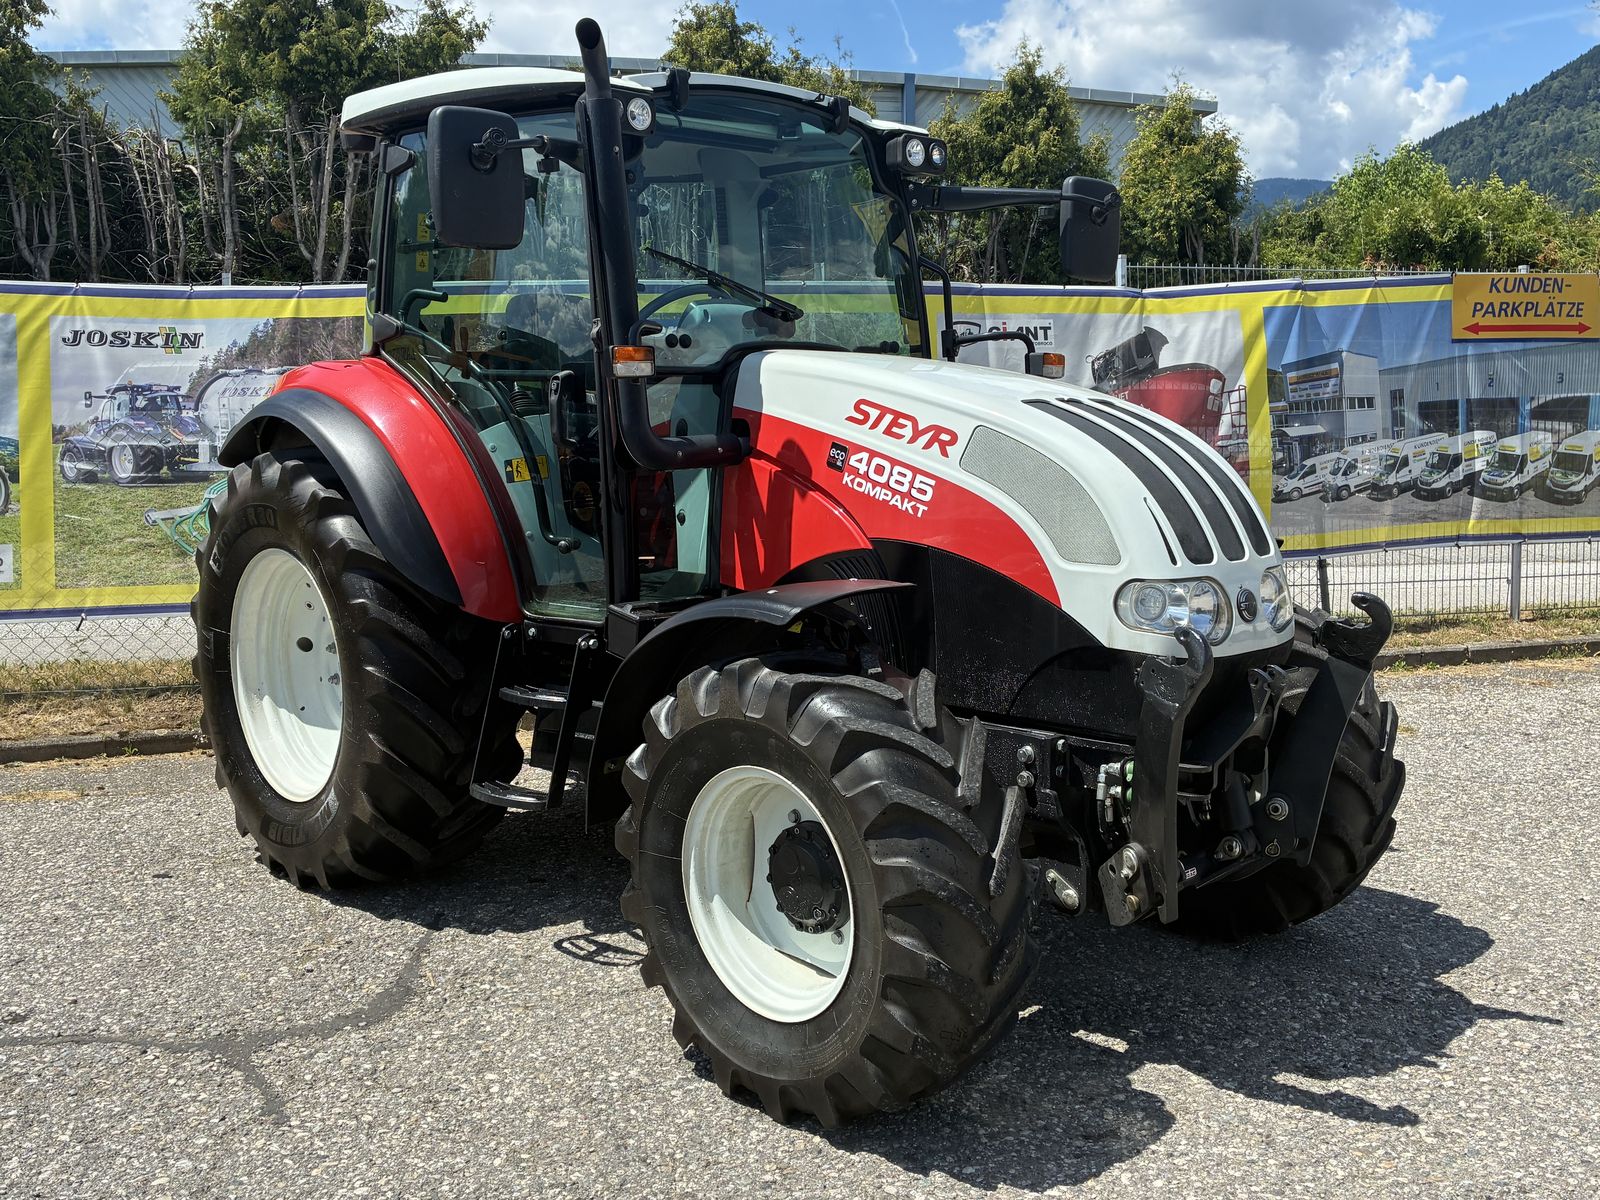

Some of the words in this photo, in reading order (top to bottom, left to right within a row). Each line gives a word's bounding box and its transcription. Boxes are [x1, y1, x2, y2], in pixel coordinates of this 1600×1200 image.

[1488, 277, 1572, 294] KUNDEN-
[1471, 296, 1585, 318] PARKPLÄTZE
[62, 328, 204, 349] JOSKIN
[218, 384, 275, 398] JOSKI
[845, 398, 959, 459] STEYR
[829, 448, 846, 460] eco
[848, 451, 936, 502] 4085
[842, 471, 929, 518] KOMPAKT
